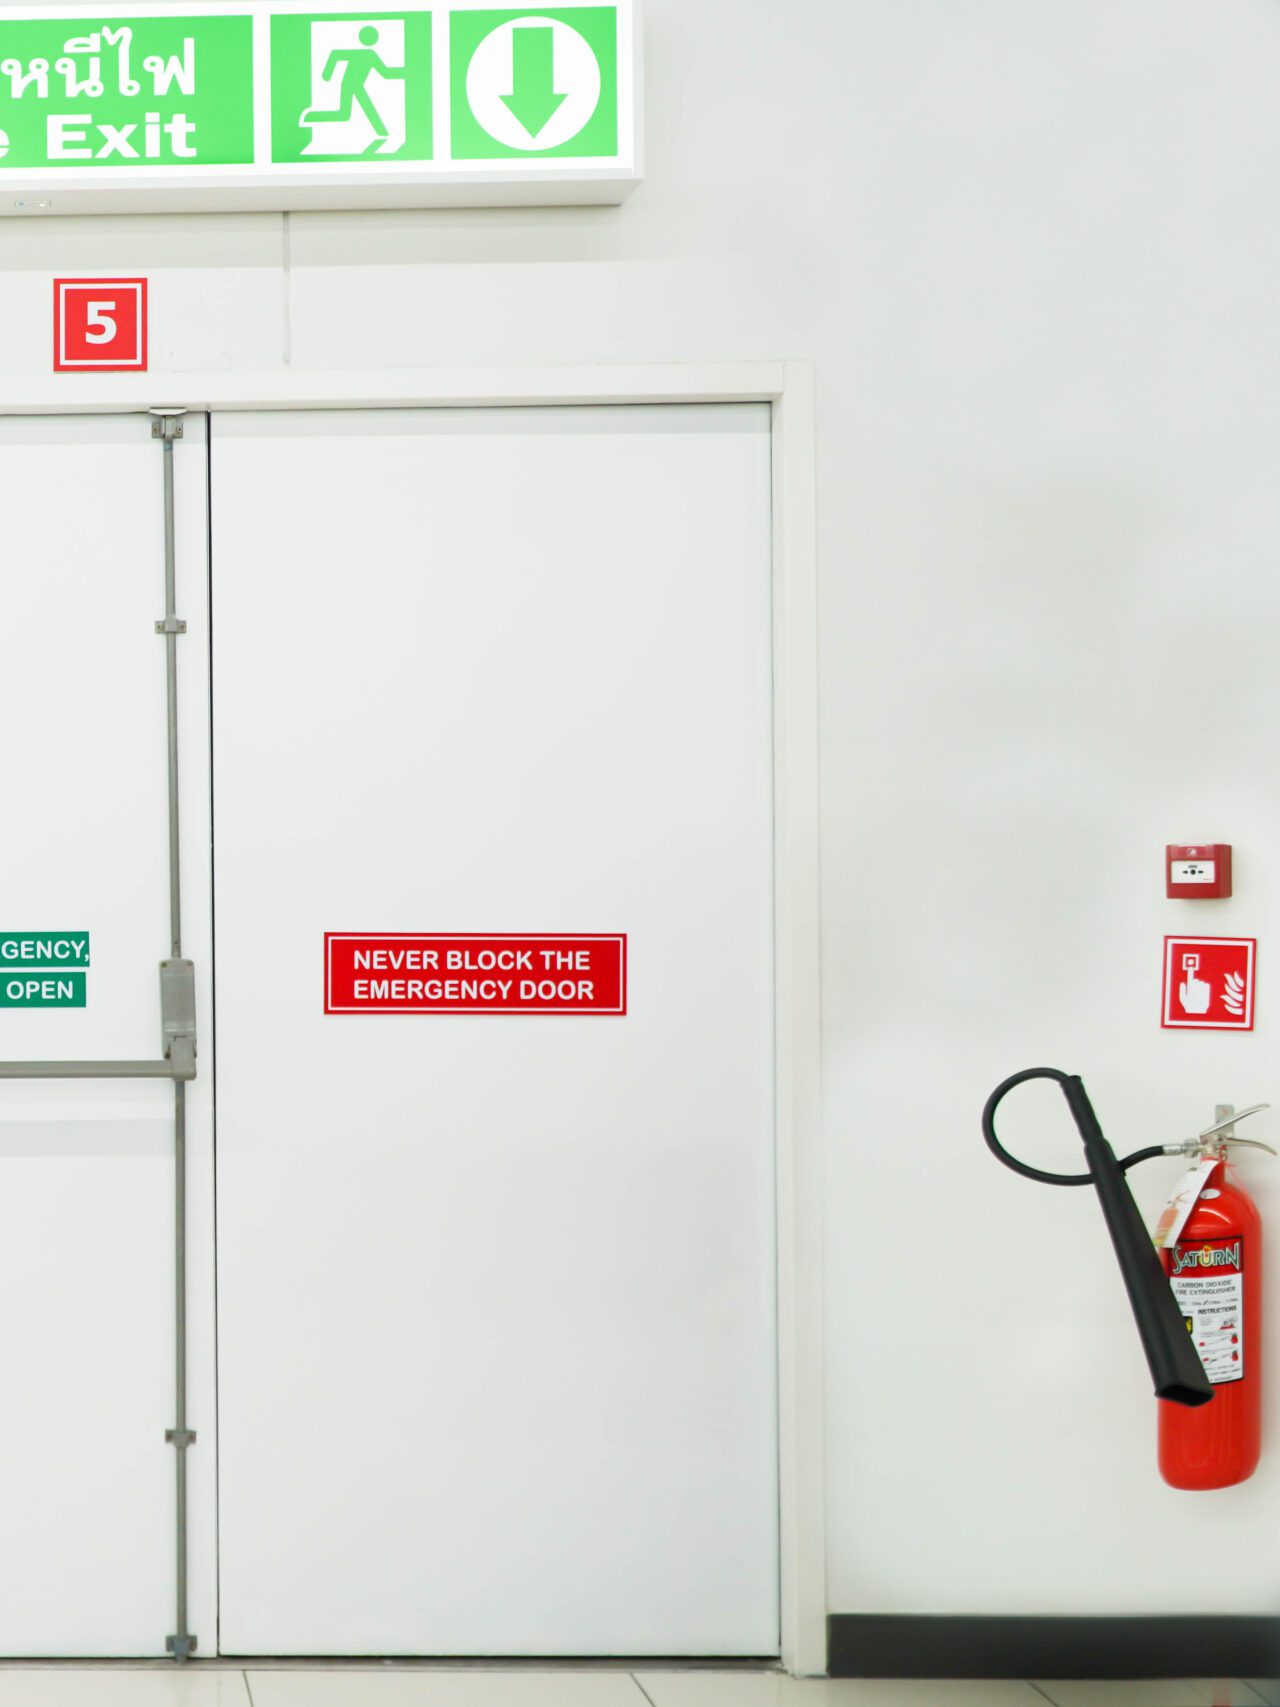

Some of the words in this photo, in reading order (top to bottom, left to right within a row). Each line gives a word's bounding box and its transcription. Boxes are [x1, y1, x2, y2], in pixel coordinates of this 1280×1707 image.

[46, 112, 197, 159] Exit
[85, 301, 117, 344] 5
[353, 950, 439, 970] NEVER
[446, 950, 533, 970] BLOCK
[539, 950, 591, 970] THE
[6, 981, 73, 1000] OPEN
[353, 980, 513, 1000] EMERGENCY
[520, 980, 594, 1000] DOOR
[1172, 1242, 1239, 1274] SATURN
[1197, 1305, 1237, 1315] INSTRUCTIONS
